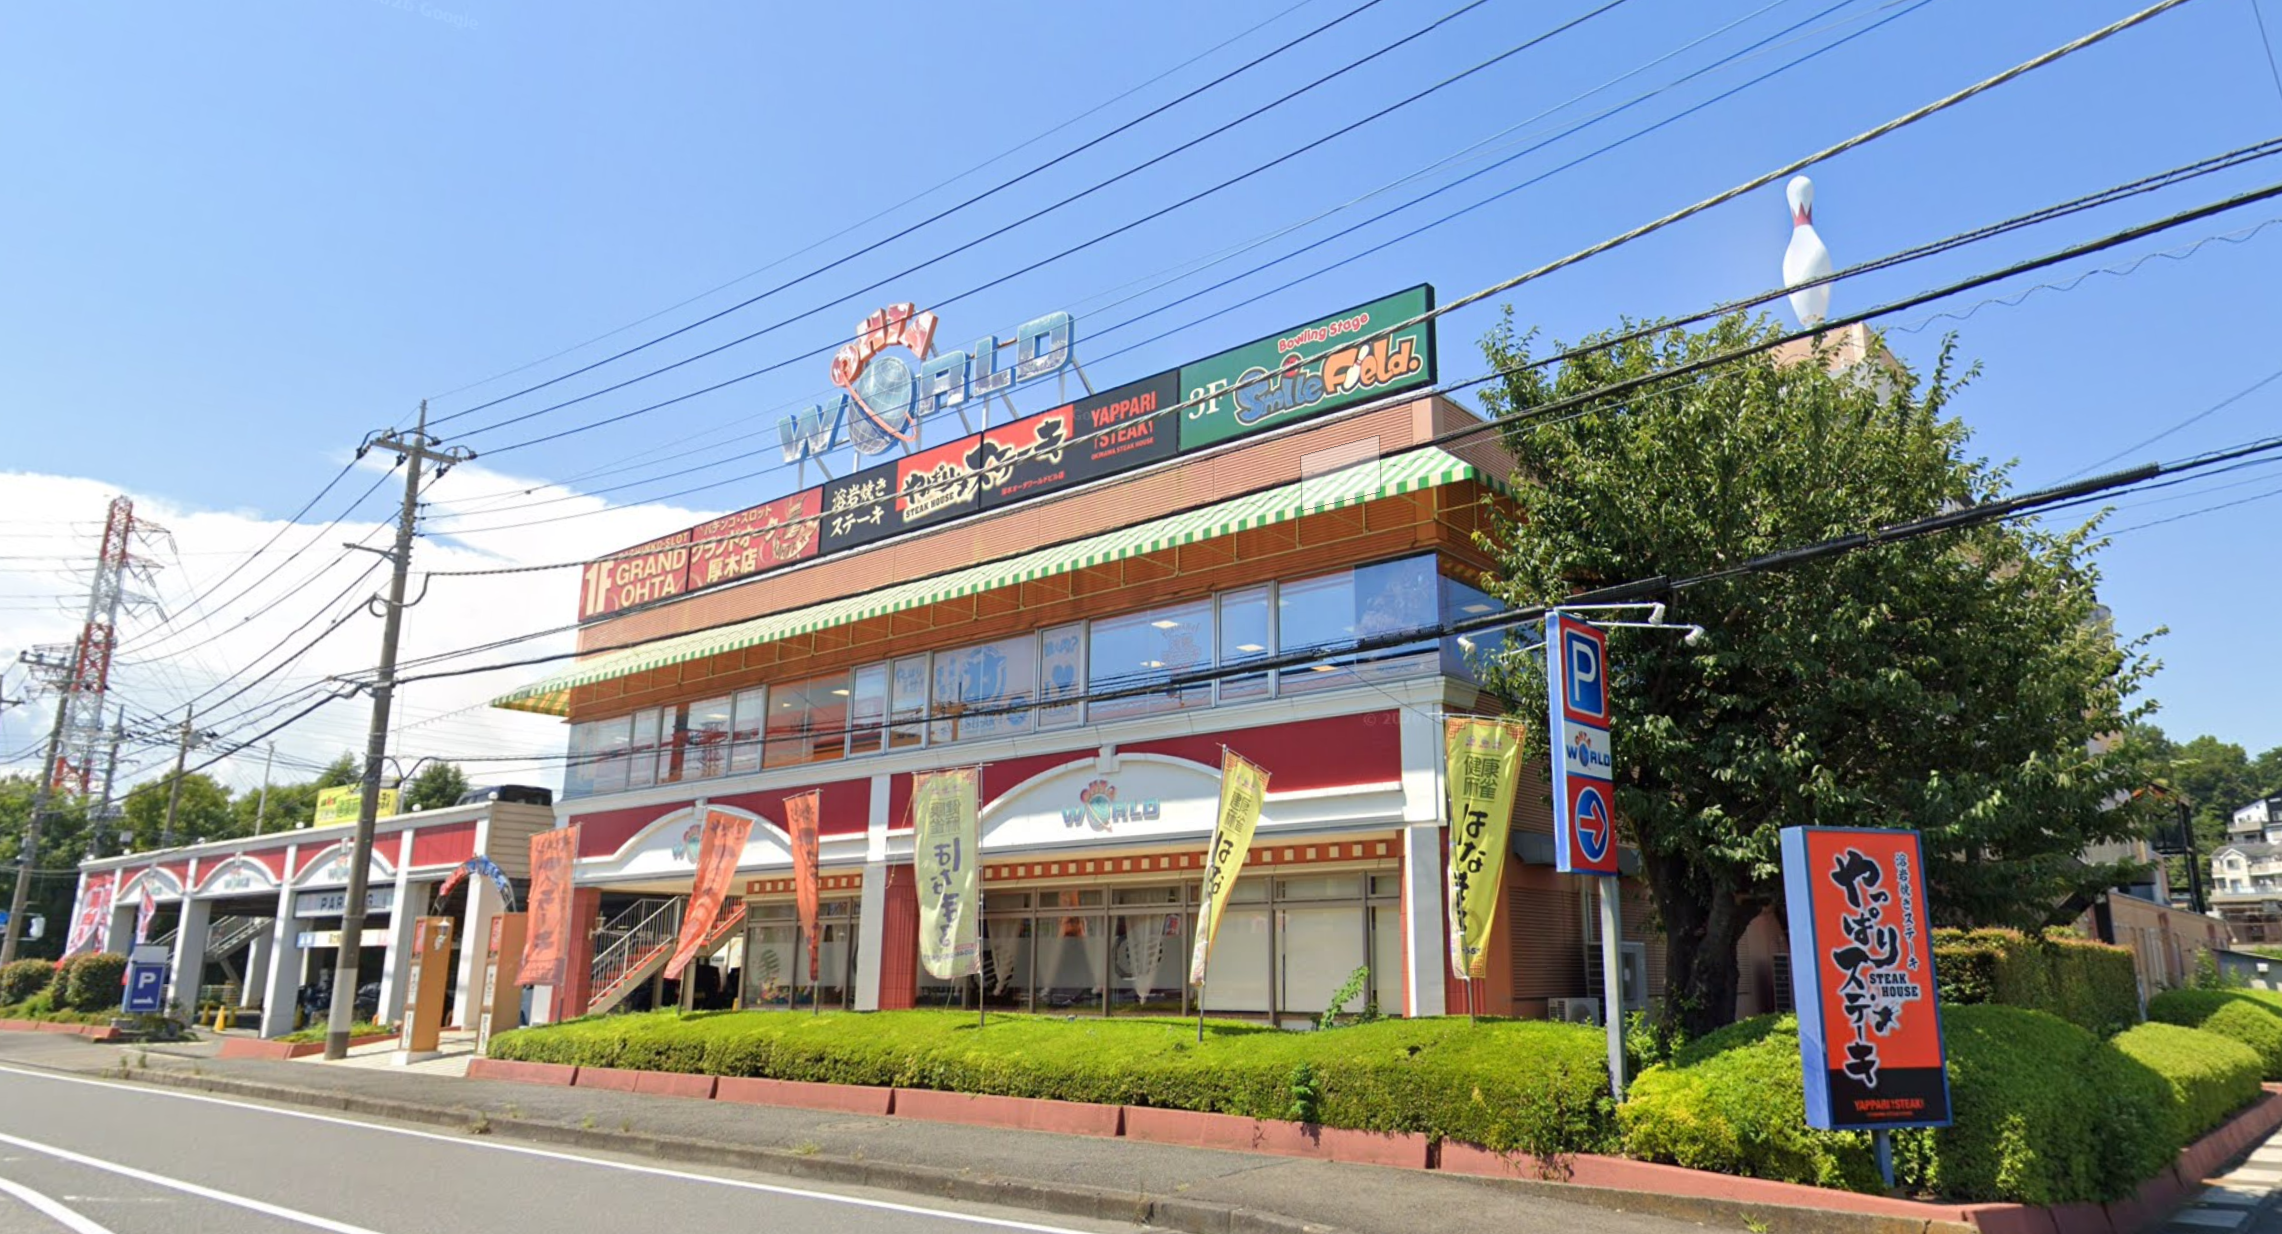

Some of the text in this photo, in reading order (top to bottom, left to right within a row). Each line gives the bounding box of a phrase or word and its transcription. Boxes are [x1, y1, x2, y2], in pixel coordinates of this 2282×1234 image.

[1278, 313, 1369, 352] Bowling Stage
[777, 311, 1074, 464] WORLD
[1188, 378, 1228, 420] 3F
[1091, 390, 1156, 428] YAPPARI
[832, 477, 888, 511] 溶岩焼き
[905, 491, 954, 518] STEAK HOUSE
[830, 504, 885, 538] ステーキ
[615, 548, 686, 586] GRAND
[707, 548, 758, 584] 厚木店
[584, 560, 614, 617] 1F
[621, 573, 676, 607] OHTA
[1572, 640, 1597, 702] P
[1464, 755, 1500, 779] 健康
[1566, 744, 1611, 768] WORLD
[1463, 776, 1499, 800] 麻雀
[1062, 798, 1161, 832] WORLD
[320, 893, 374, 911] PARG
[1895, 852, 1919, 970] 溶岩焼きステーキ
[138, 972, 156, 989] P
[1831, 850, 1899, 1087] やっぱりステーキ
[1869, 973, 1906, 985] STEAK
[1882, 984, 1919, 998] HOUSE
